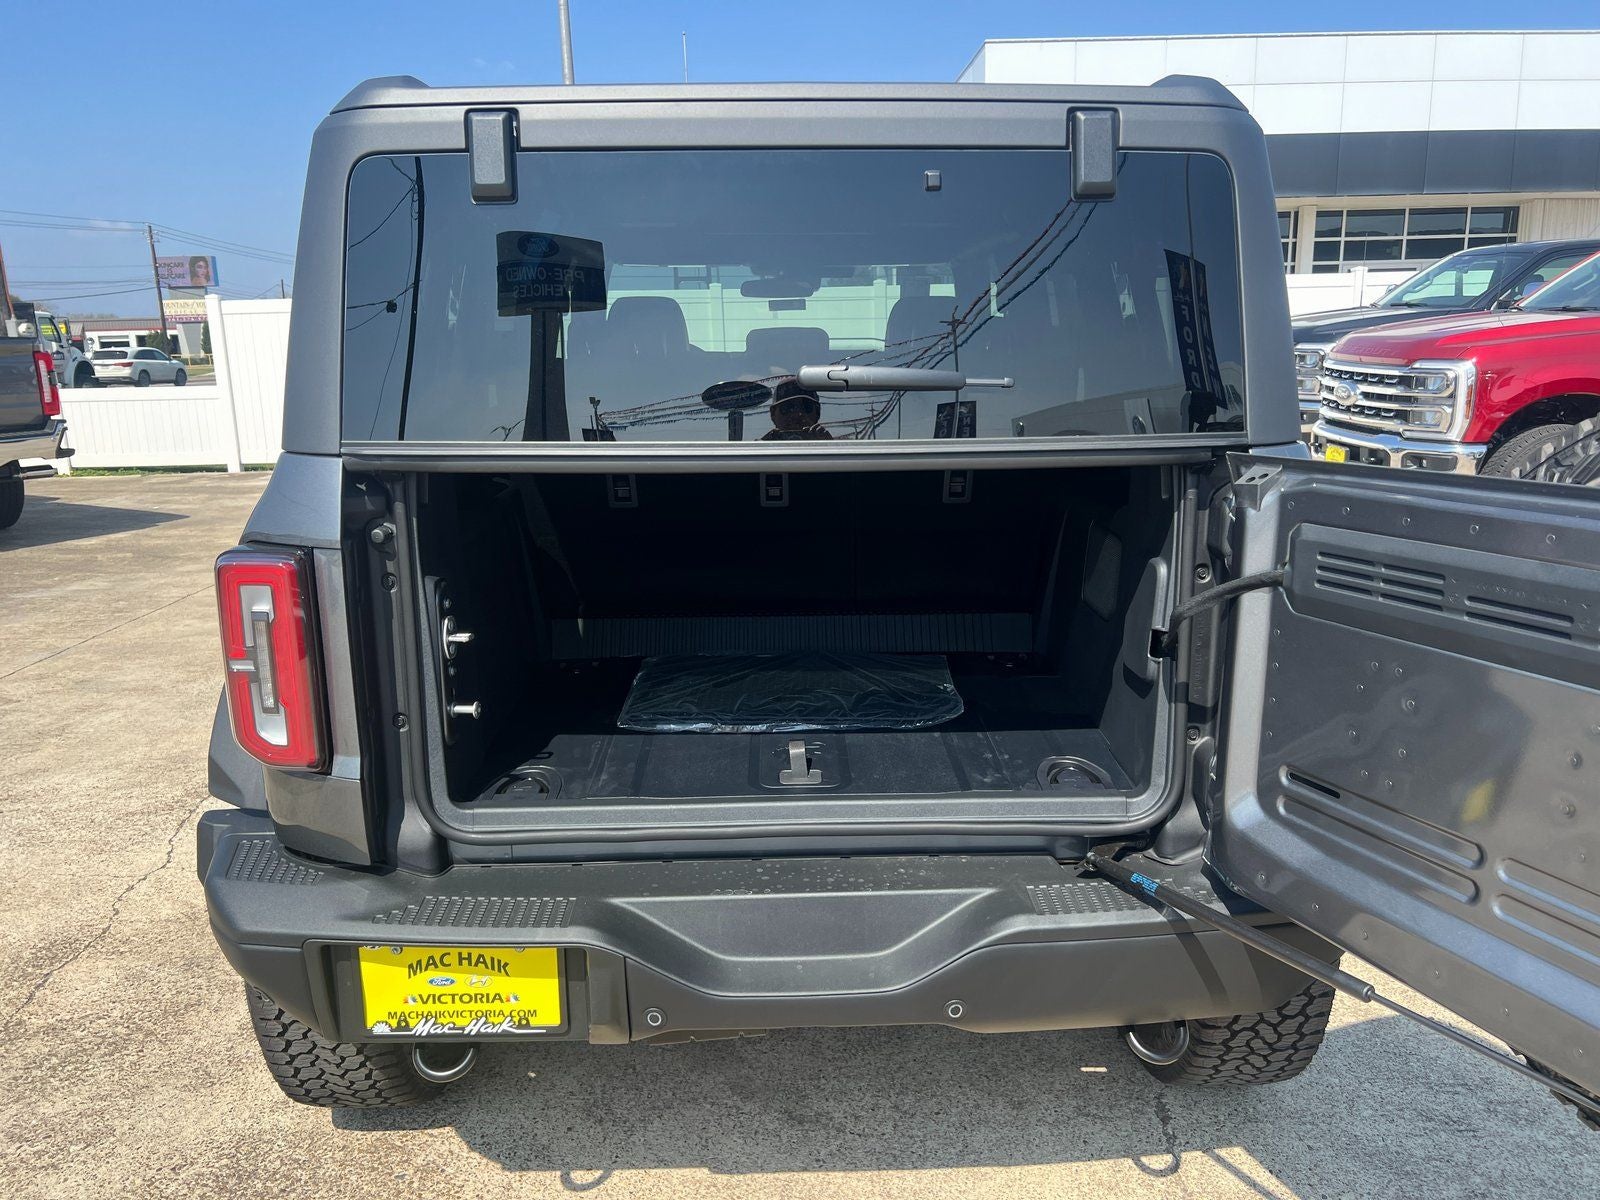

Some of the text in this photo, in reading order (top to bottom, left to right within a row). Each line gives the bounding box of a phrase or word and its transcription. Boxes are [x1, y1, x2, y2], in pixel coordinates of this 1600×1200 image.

[407, 951, 511, 979] MAC HAIK
[430, 977, 454, 986] Ford
[418, 992, 505, 1005] VICTORIA
[387, 1009, 538, 1020] MACHAIKVICTORIA.COM
[411, 1016, 519, 1037] Mac Haik
